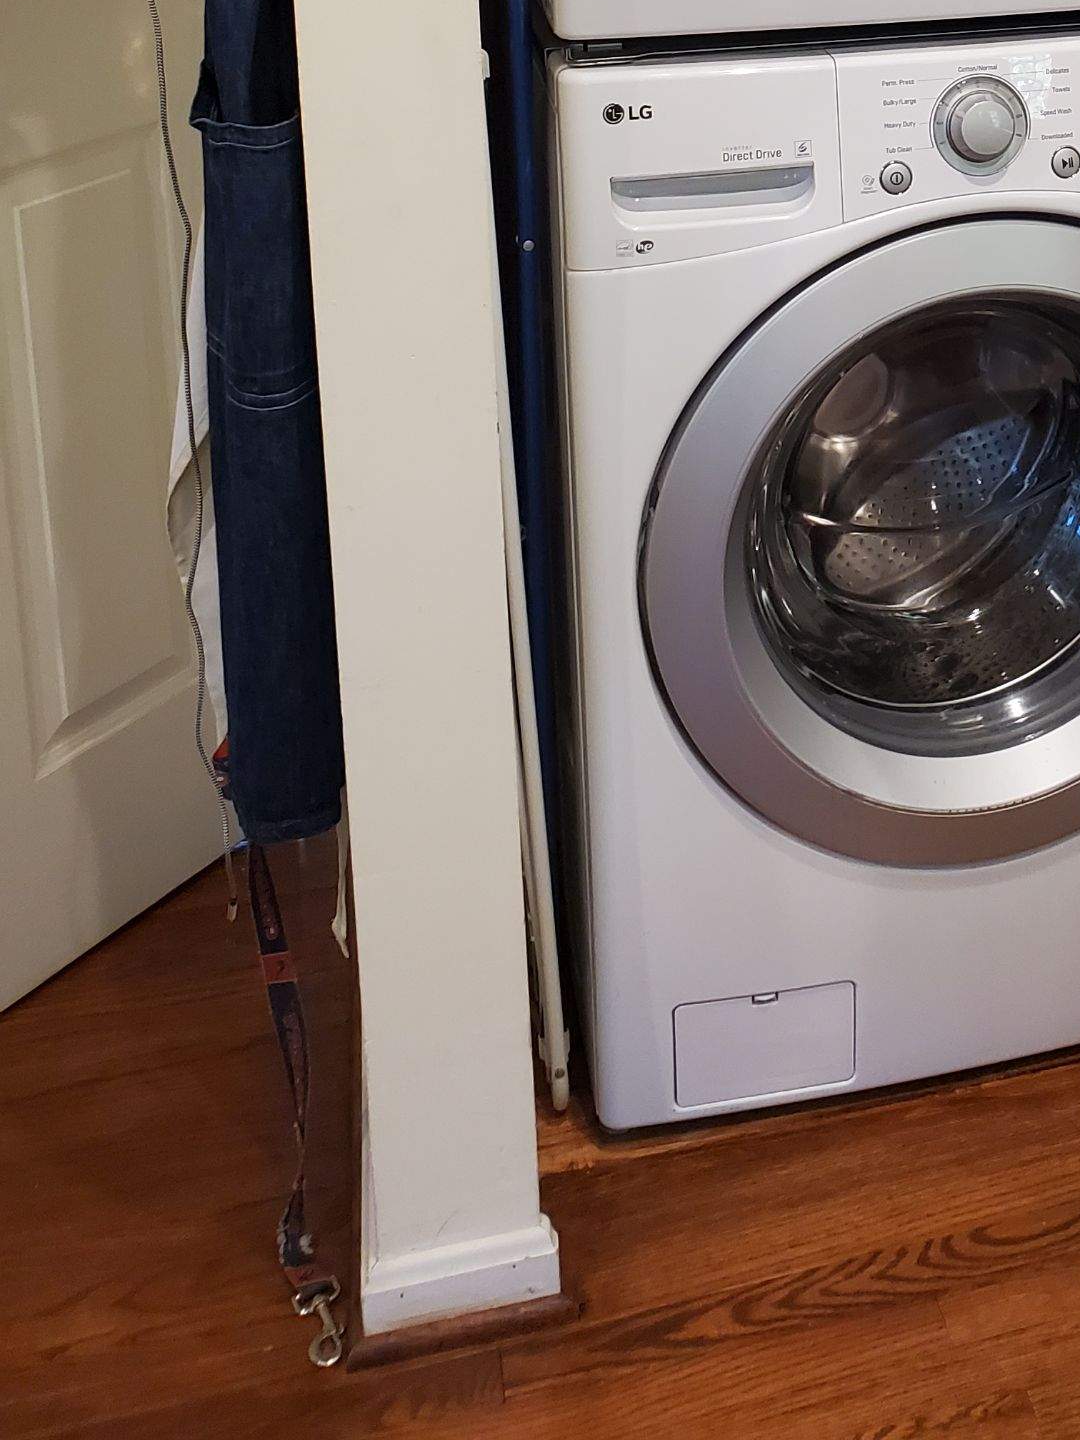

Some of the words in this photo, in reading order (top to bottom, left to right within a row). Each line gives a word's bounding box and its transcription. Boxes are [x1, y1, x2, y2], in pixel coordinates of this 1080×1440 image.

[957, 64, 998, 72] Cotton/Normal
[1045, 67, 1070, 75] Delicates
[898, 78, 915, 86] Press
[1052, 86, 1071, 94] Towels
[628, 104, 653, 121] LG
[1040, 109, 1057, 117] Speed
[1057, 107, 1072, 115] Wash
[884, 121, 901, 129] Heavy
[902, 120, 917, 128] Duty
[1041, 132, 1074, 141] Downloaded
[722, 151, 754, 162] Direct
[755, 148, 783, 160] Drive
